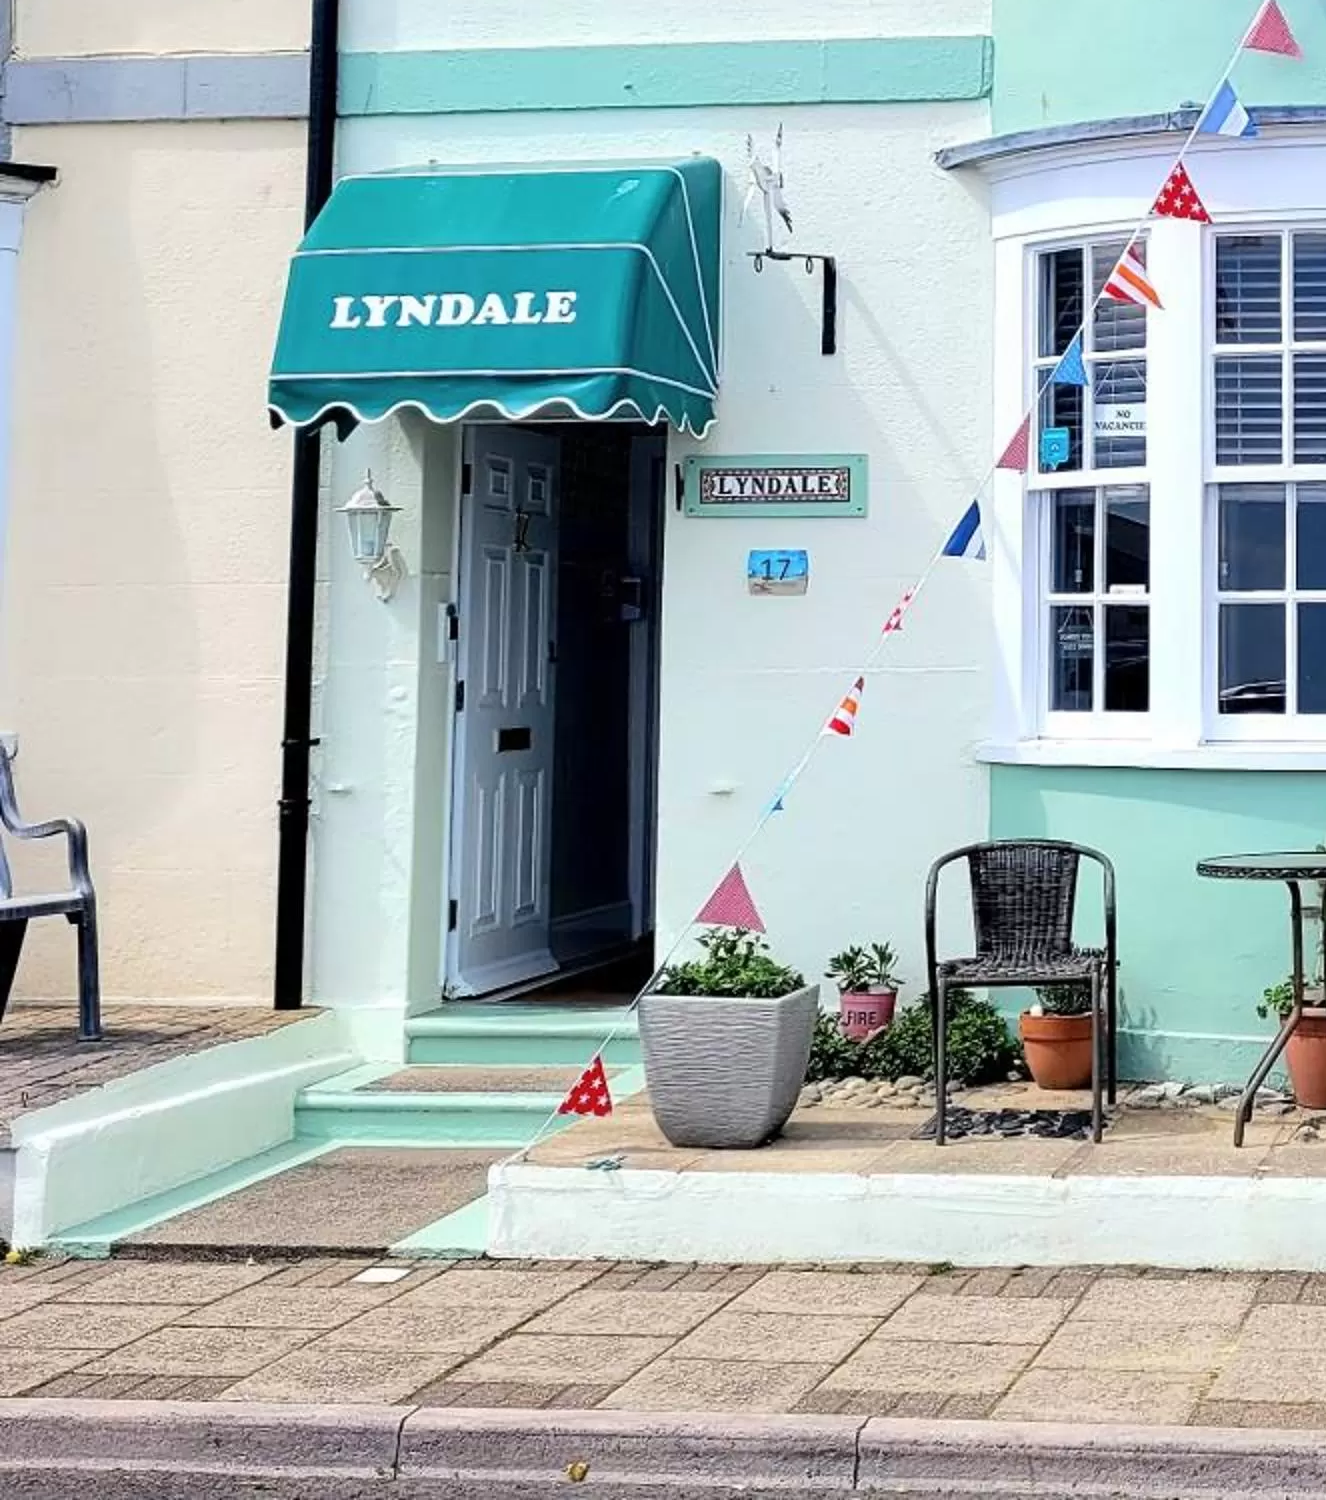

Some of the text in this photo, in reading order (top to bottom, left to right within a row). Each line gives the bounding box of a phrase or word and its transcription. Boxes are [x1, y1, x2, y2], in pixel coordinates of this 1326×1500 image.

[329, 291, 577, 329] LYNDALE
[1115, 409, 1131, 419] NO
[1094, 421, 1147, 431] VACANCIE
[718, 475, 832, 495] LYNDALE
[760, 558, 792, 581] 17
[846, 1010, 877, 1025] FIRE
